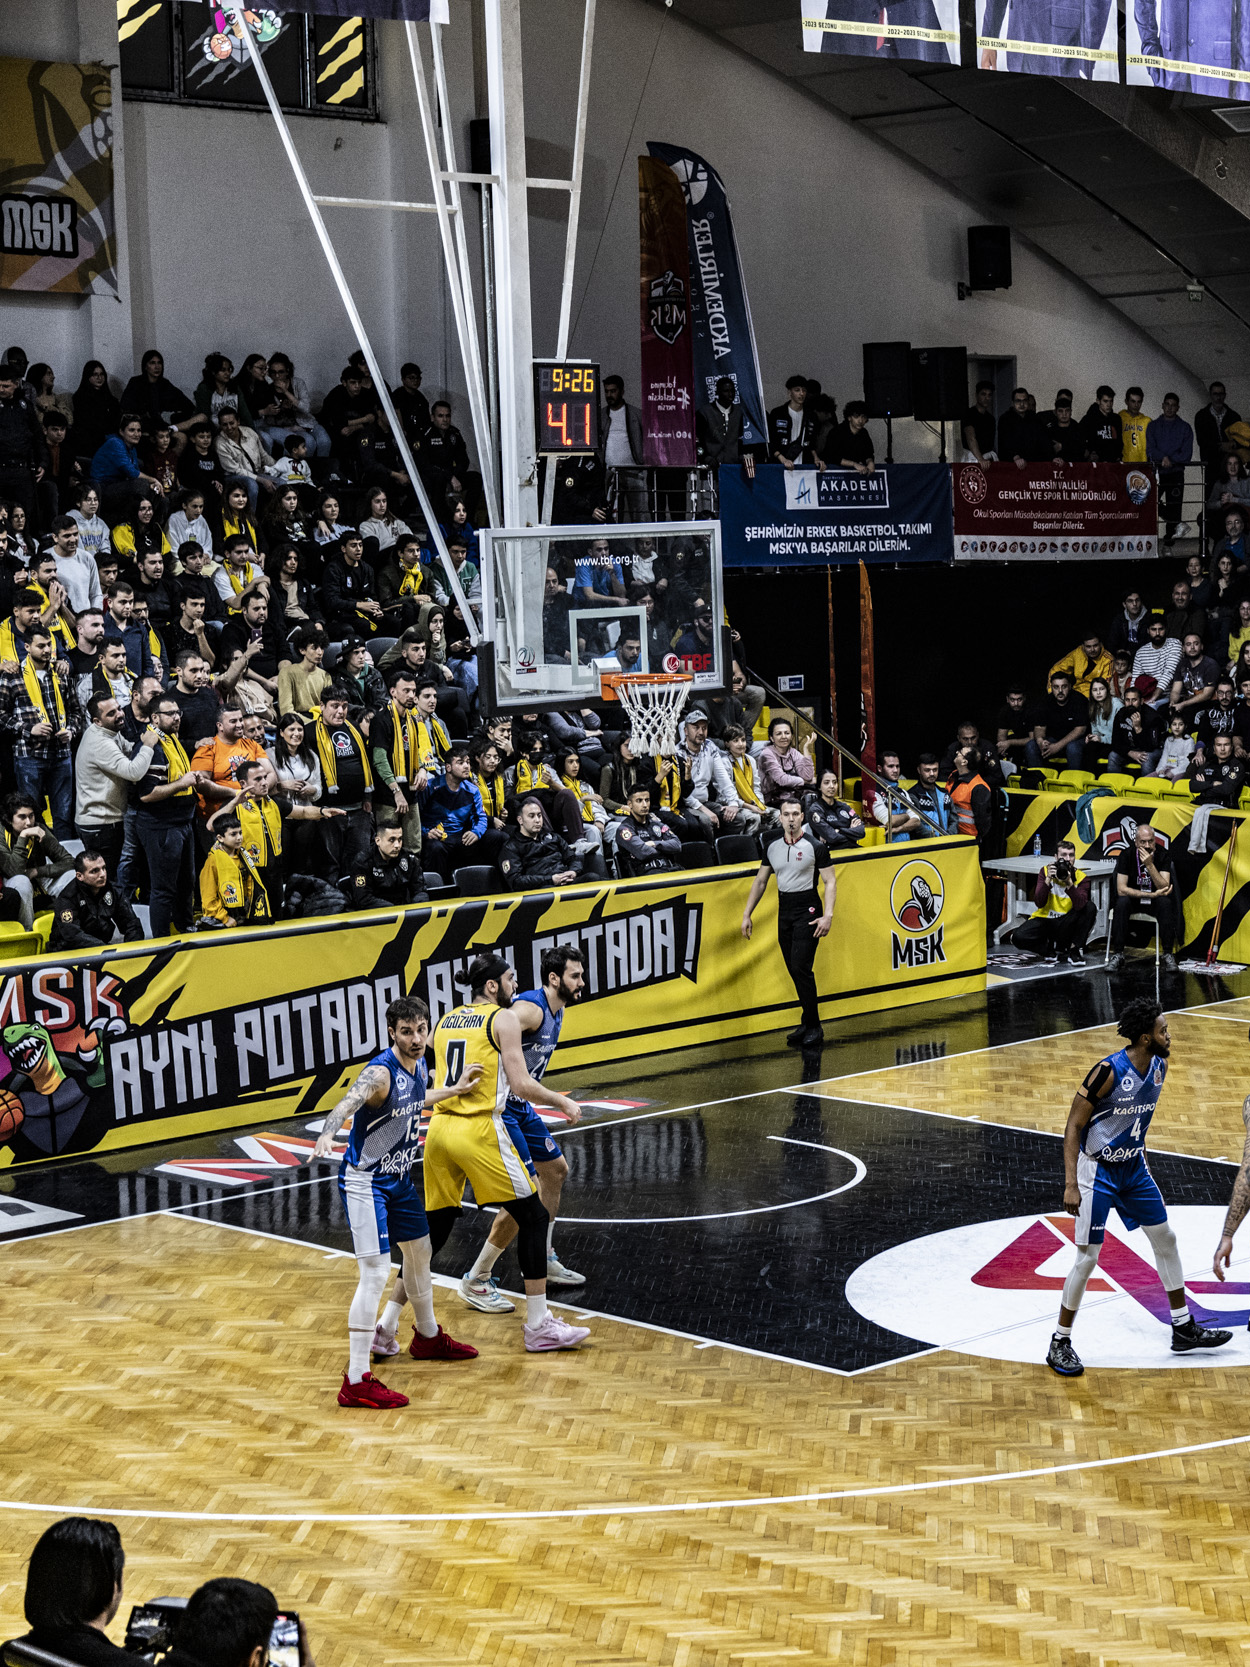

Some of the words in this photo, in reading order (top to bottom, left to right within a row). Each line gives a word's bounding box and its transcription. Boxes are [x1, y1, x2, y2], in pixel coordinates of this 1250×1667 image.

[887, 28, 916, 36] 2022-2023
[1052, 47, 1075, 55] 2022-2023
[2, 199, 74, 253] MSK
[552, 368, 594, 393] 9:26
[547, 402, 591, 446] 4.1
[1053, 471, 1065, 480] T.C.
[820, 477, 883, 492] AKADEMİ
[1029, 481, 1058, 490] MERSİN
[1059, 480, 1088, 490] VALİLİĞİ
[820, 494, 885, 502] HASTANESİ
[998, 490, 1031, 502] GENÇLİK
[1032, 492, 1042, 500] VE
[1043, 491, 1062, 500] SPOR
[1071, 491, 1117, 501] MÜDÜRLÜĞÜ
[973, 508, 989, 518] Okul
[1084, 510, 1099, 520] Tüm
[745, 523, 804, 542] ŞEHRİMİZİN
[806, 526, 838, 538] ERKEK
[840, 524, 898, 537] BASKETBOL
[898, 523, 932, 535] TAKIMI
[769, 542, 809, 555] MSK'YA
[811, 540, 867, 556] BAŞARILAR
[869, 537, 911, 552] DİLERİM.
[574, 554, 640, 567] www.tbf.org.tr
[680, 653, 712, 671] TBF
[890, 922, 947, 971] MSK
[441, 1013, 486, 1030] OĞUZHAN
[109, 1018, 218, 1120] AYNI
[405, 1114, 420, 1142] 13
[1130, 1117, 1142, 1142] 4
